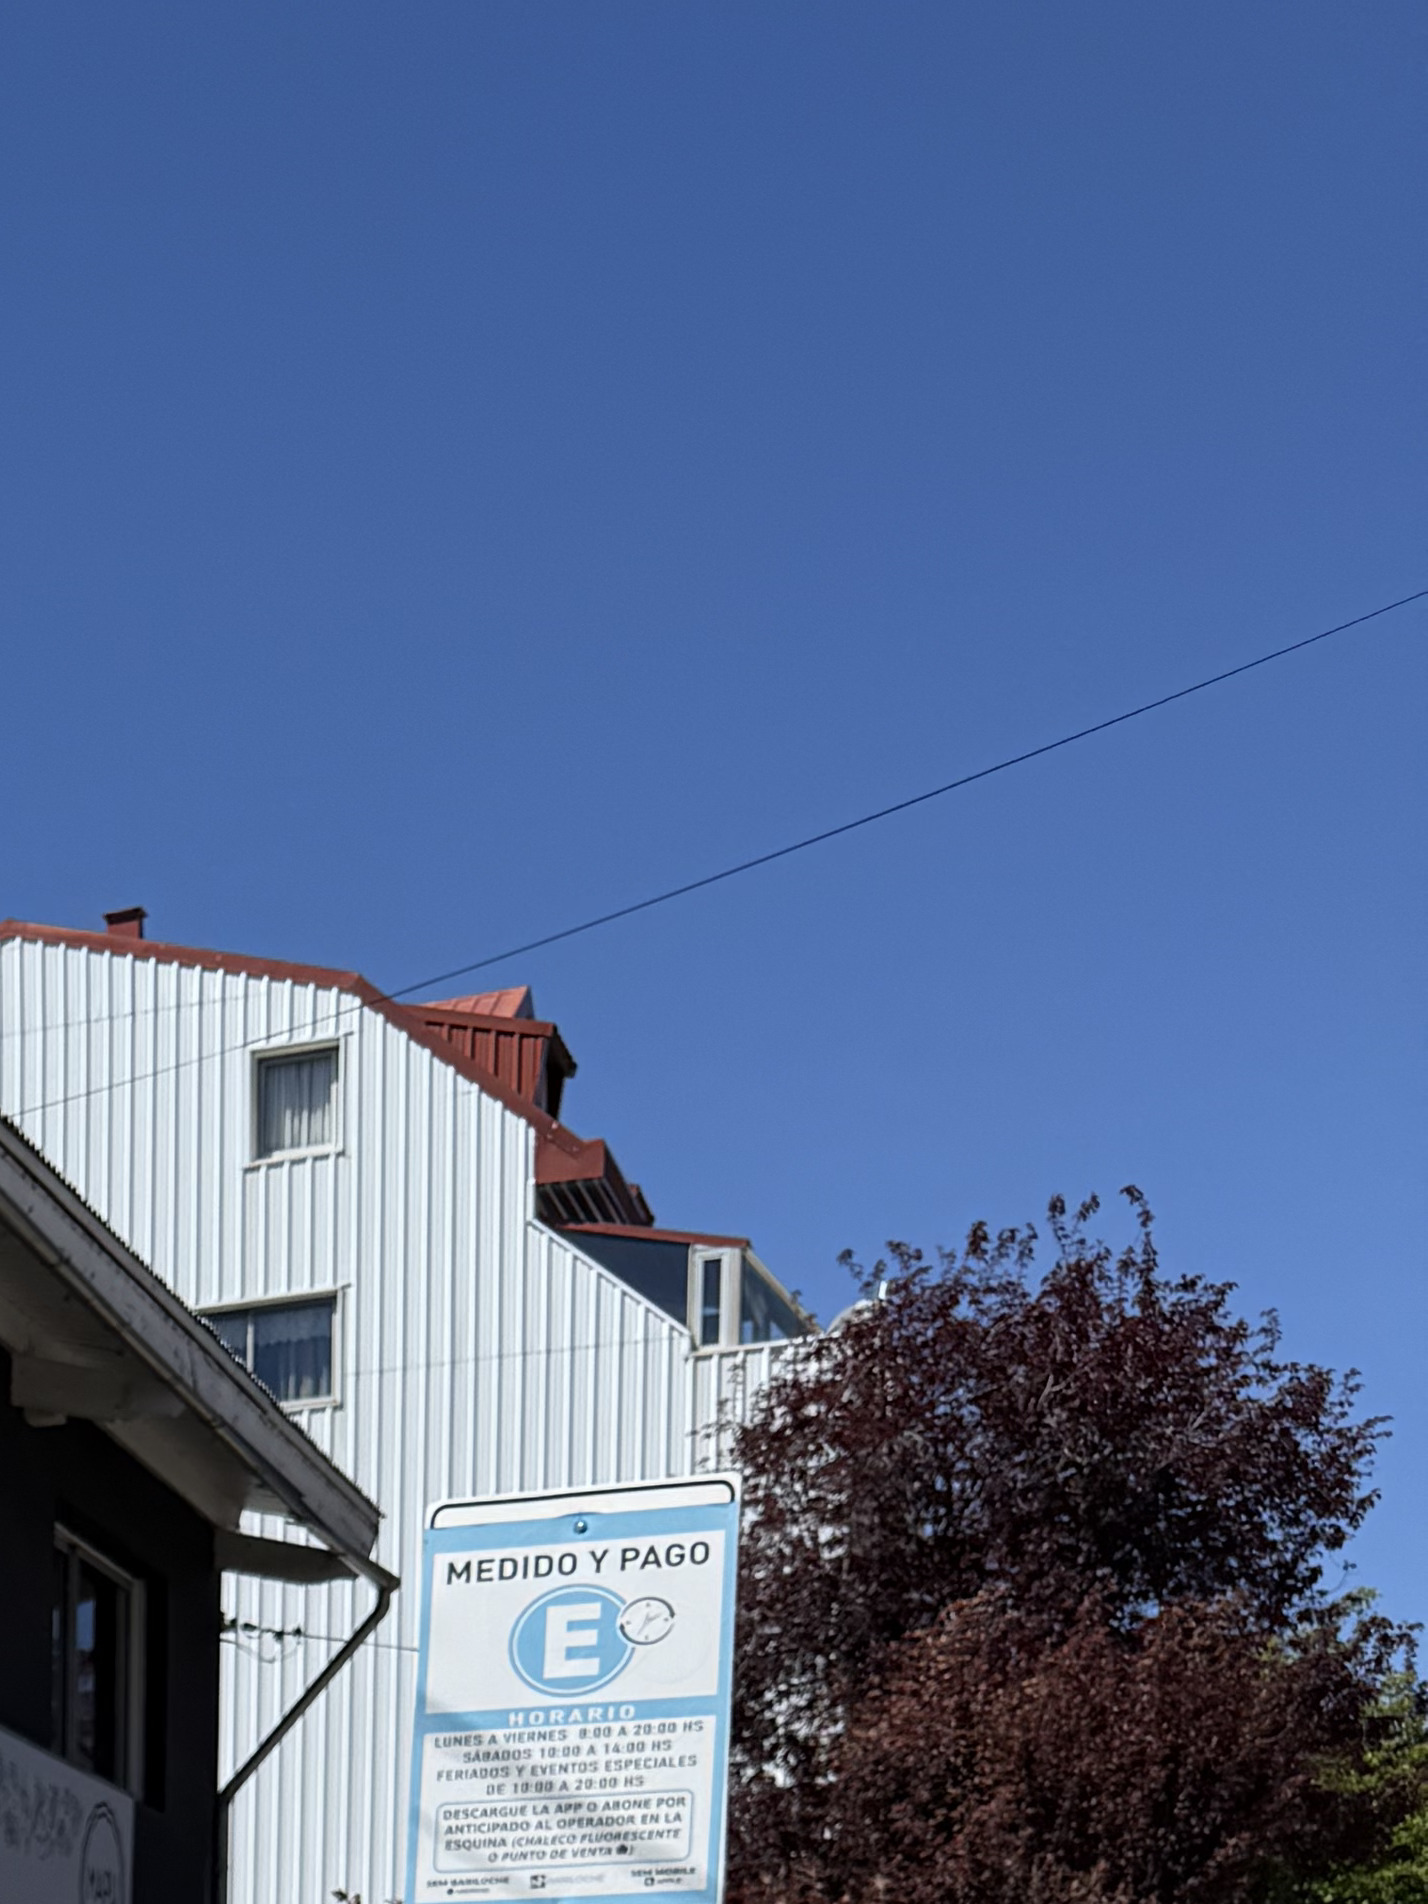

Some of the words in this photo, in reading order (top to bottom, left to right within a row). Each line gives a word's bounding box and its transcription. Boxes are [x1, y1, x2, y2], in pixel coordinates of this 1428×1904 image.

[446, 1552, 578, 1585] MEDIDO
[589, 1549, 609, 1573] Y
[620, 1541, 711, 1571] PAGO
[543, 1602, 602, 1679] E
[508, 1705, 636, 1727] HORARIO
[434, 1734, 483, 1748] LUNES
[487, 1734, 498, 1745] A
[503, 1729, 567, 1744] VIERNES
[618, 1725, 627, 1737] A
[633, 1722, 677, 1736] 20:00
[683, 1719, 704, 1732] HS
[462, 1748, 532, 1763] SÁBADOS
[540, 1745, 581, 1759] 10:00
[586, 1744, 596, 1756] A
[604, 1740, 646, 1754] 14:00
[651, 1739, 672, 1752] HS
[436, 1765, 510, 1781] FERIADOS
[515, 1765, 526, 1777] Y
[530, 1761, 598, 1777] EVENTOS
[604, 1755, 697, 1772] ESPECIALES
[486, 1783, 506, 1795] DE
[513, 1780, 553, 1794] 10:00
[558, 1780, 569, 1792] A
[575, 1777, 618, 1790] 20:00
[623, 1775, 645, 1788] HS
[442, 1804, 528, 1821] DESCARGUE
[532, 1804, 550, 1816] LA
[553, 1802, 583, 1815] APP
[586, 1801, 598, 1812] O
[601, 1798, 652, 1812] ABONE
[656, 1796, 686, 1808] POR
[443, 1820, 531, 1836] ANTICIPADO
[534, 1820, 552, 1831] AL
[556, 1814, 636, 1830] OPERADOR
[640, 1814, 659, 1825] EN
[664, 1812, 683, 1823] LA
[444, 1837, 507, 1852] ESQUINA
[511, 1834, 577, 1849] (CHALECO
[579, 1829, 682, 1844] FLUORESCENTE
[487, 1852, 498, 1863] O
[501, 1850, 547, 1862] PUNTO
[549, 1849, 569, 1860] DE
